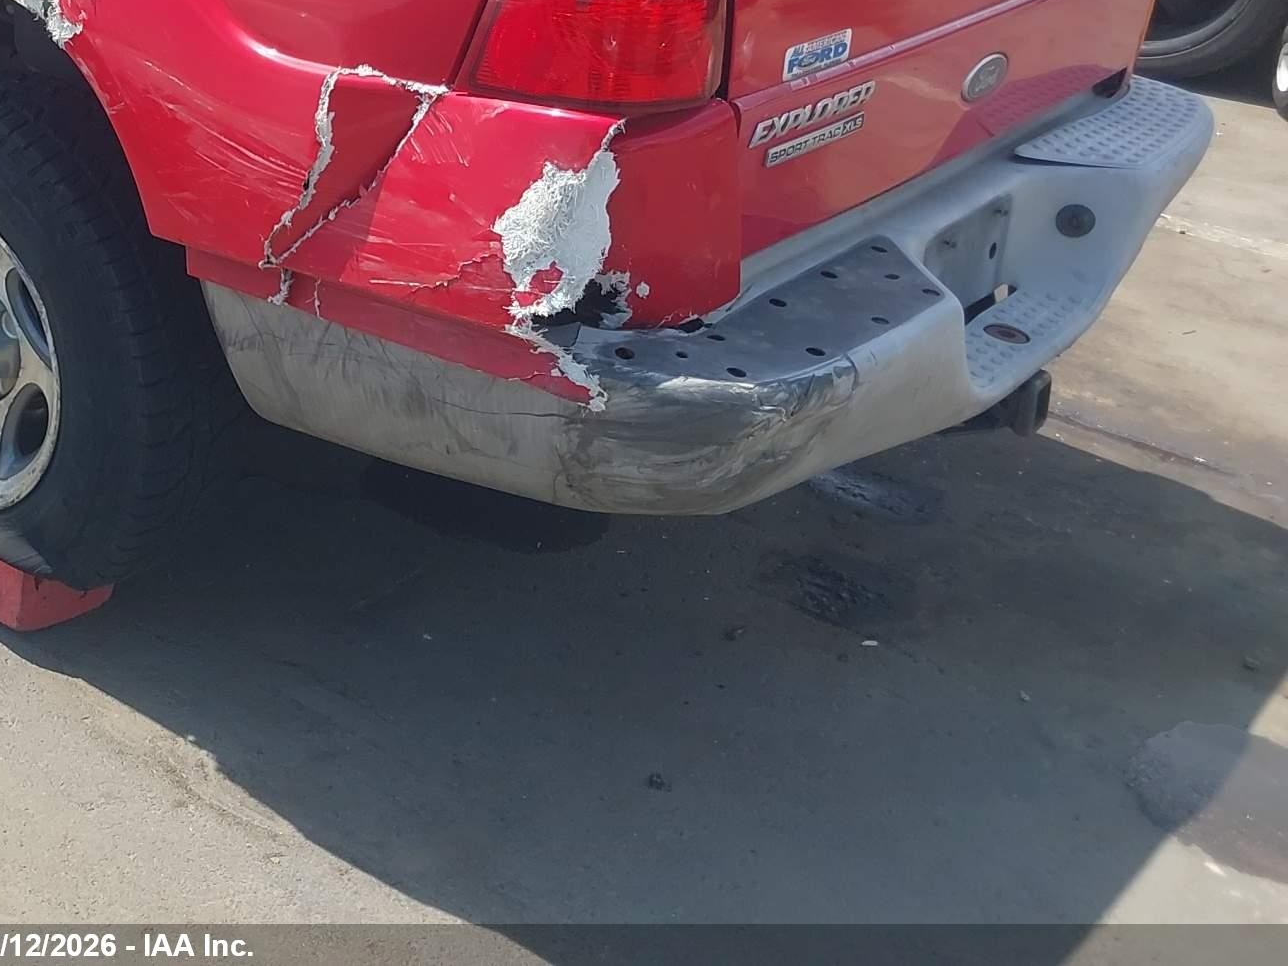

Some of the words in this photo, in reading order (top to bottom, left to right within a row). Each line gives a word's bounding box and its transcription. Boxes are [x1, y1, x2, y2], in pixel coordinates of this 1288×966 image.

[787, 41, 848, 75] FORD
[747, 80, 876, 149] EXPLORER
[769, 138, 810, 163] SPORT
[811, 126, 841, 145] TRAC
[842, 116, 863, 134] XLS
